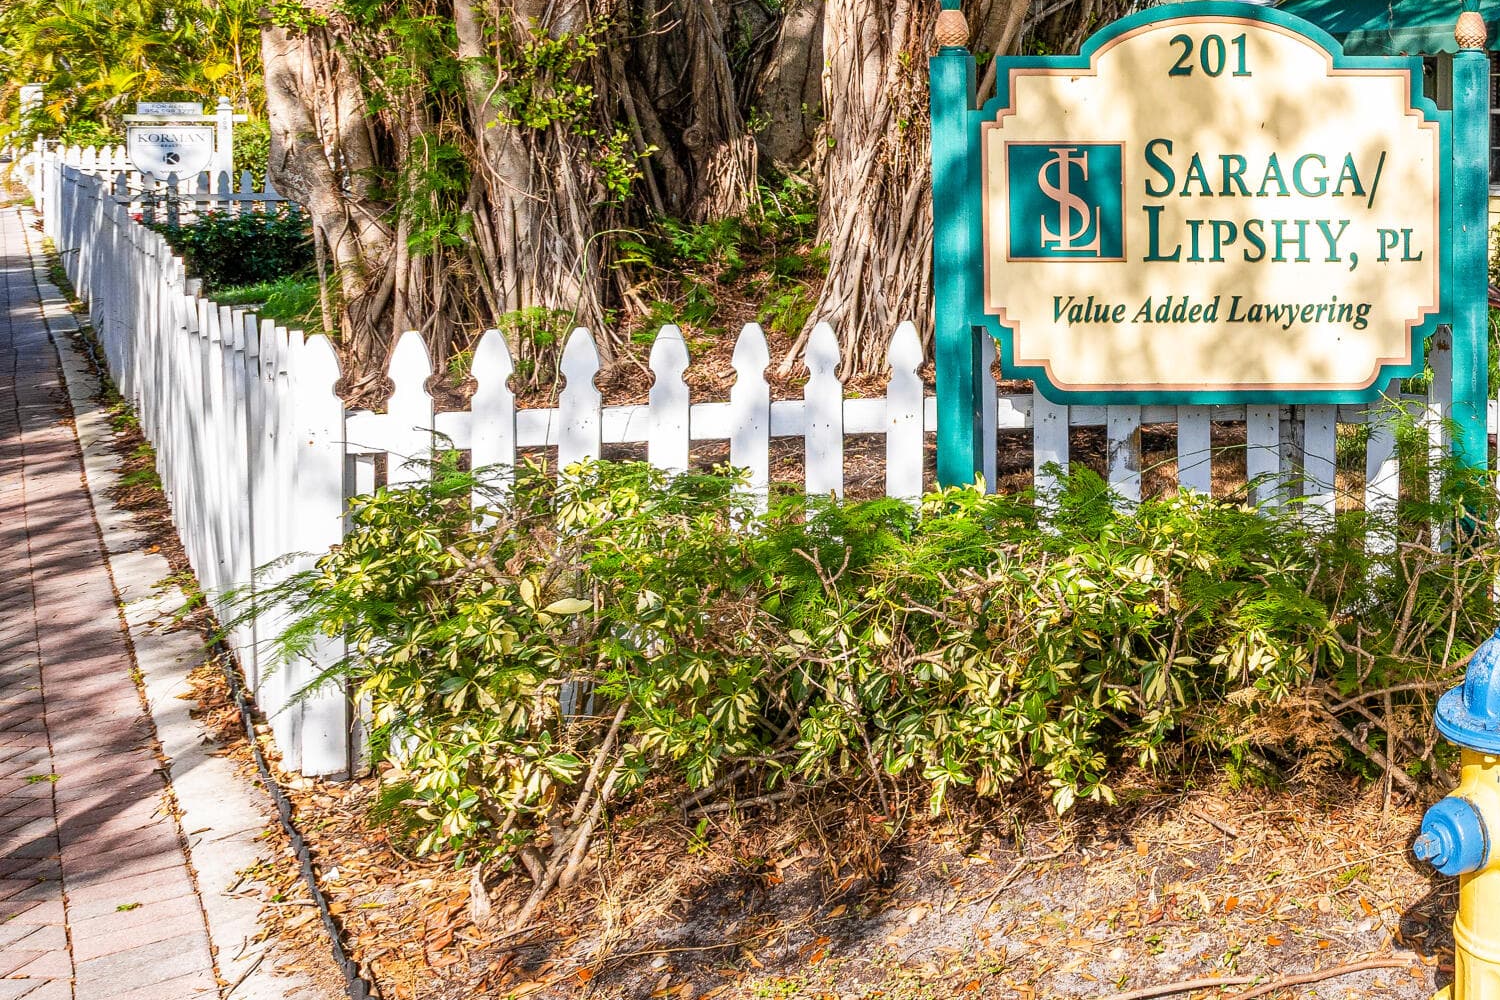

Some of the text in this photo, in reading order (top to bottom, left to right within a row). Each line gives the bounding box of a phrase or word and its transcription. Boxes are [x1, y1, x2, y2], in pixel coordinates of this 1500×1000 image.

[1168, 33, 1252, 76] 201
[138, 133, 205, 142] KORMAN
[1142, 204, 1424, 272] LIPSHY, PL
[1052, 294, 1373, 331] Value Added Lawyering
